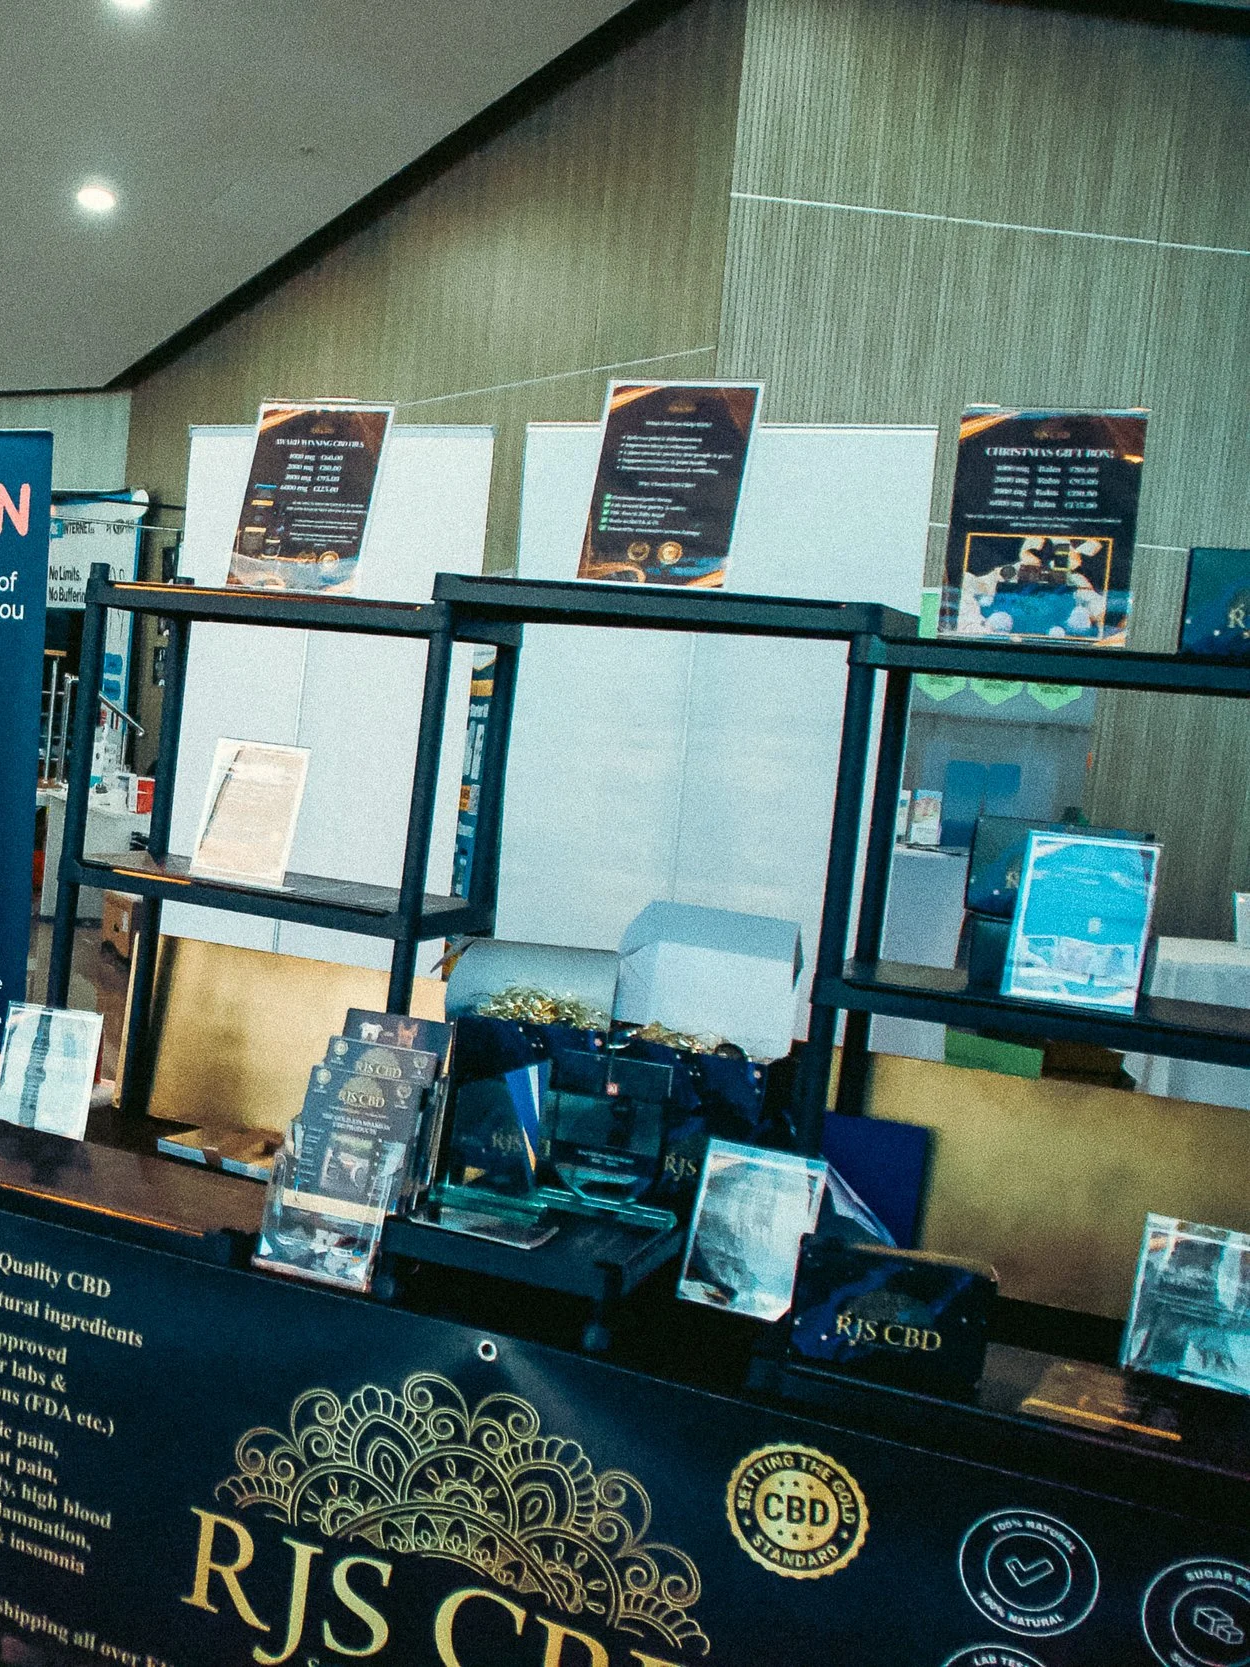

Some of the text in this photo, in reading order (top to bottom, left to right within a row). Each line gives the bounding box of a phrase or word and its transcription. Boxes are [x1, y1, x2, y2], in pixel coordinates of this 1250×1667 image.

[58, 587, 86, 603] Bufferin
[358, 1094, 386, 1108] CBD
[664, 1152, 698, 1182] RJS
[67, 1270, 112, 1298] CBD
[44, 1304, 144, 1348] ingredients
[836, 1312, 942, 1352] RJS CBD
[12, 1360, 46, 1386] labs
[50, 1373, 67, 1393] &
[24, 1392, 72, 1421] (FDA
[76, 1410, 114, 1438] etc.)
[17, 1430, 60, 1460] pain,
[16, 1454, 58, 1485] pain,
[21, 1482, 58, 1512] high
[63, 1497, 112, 1530] blood
[801, 1456, 835, 1482] THE
[832, 1480, 856, 1524] GOLD
[764, 1492, 830, 1526] CBD
[10, 1532, 86, 1576] insomnia
[752, 1533, 839, 1568] STANDARD
[180, 1507, 682, 1667] RJS CB
[1008, 1611, 1065, 1628] NATURAL
[73, 1629, 96, 1651] all
